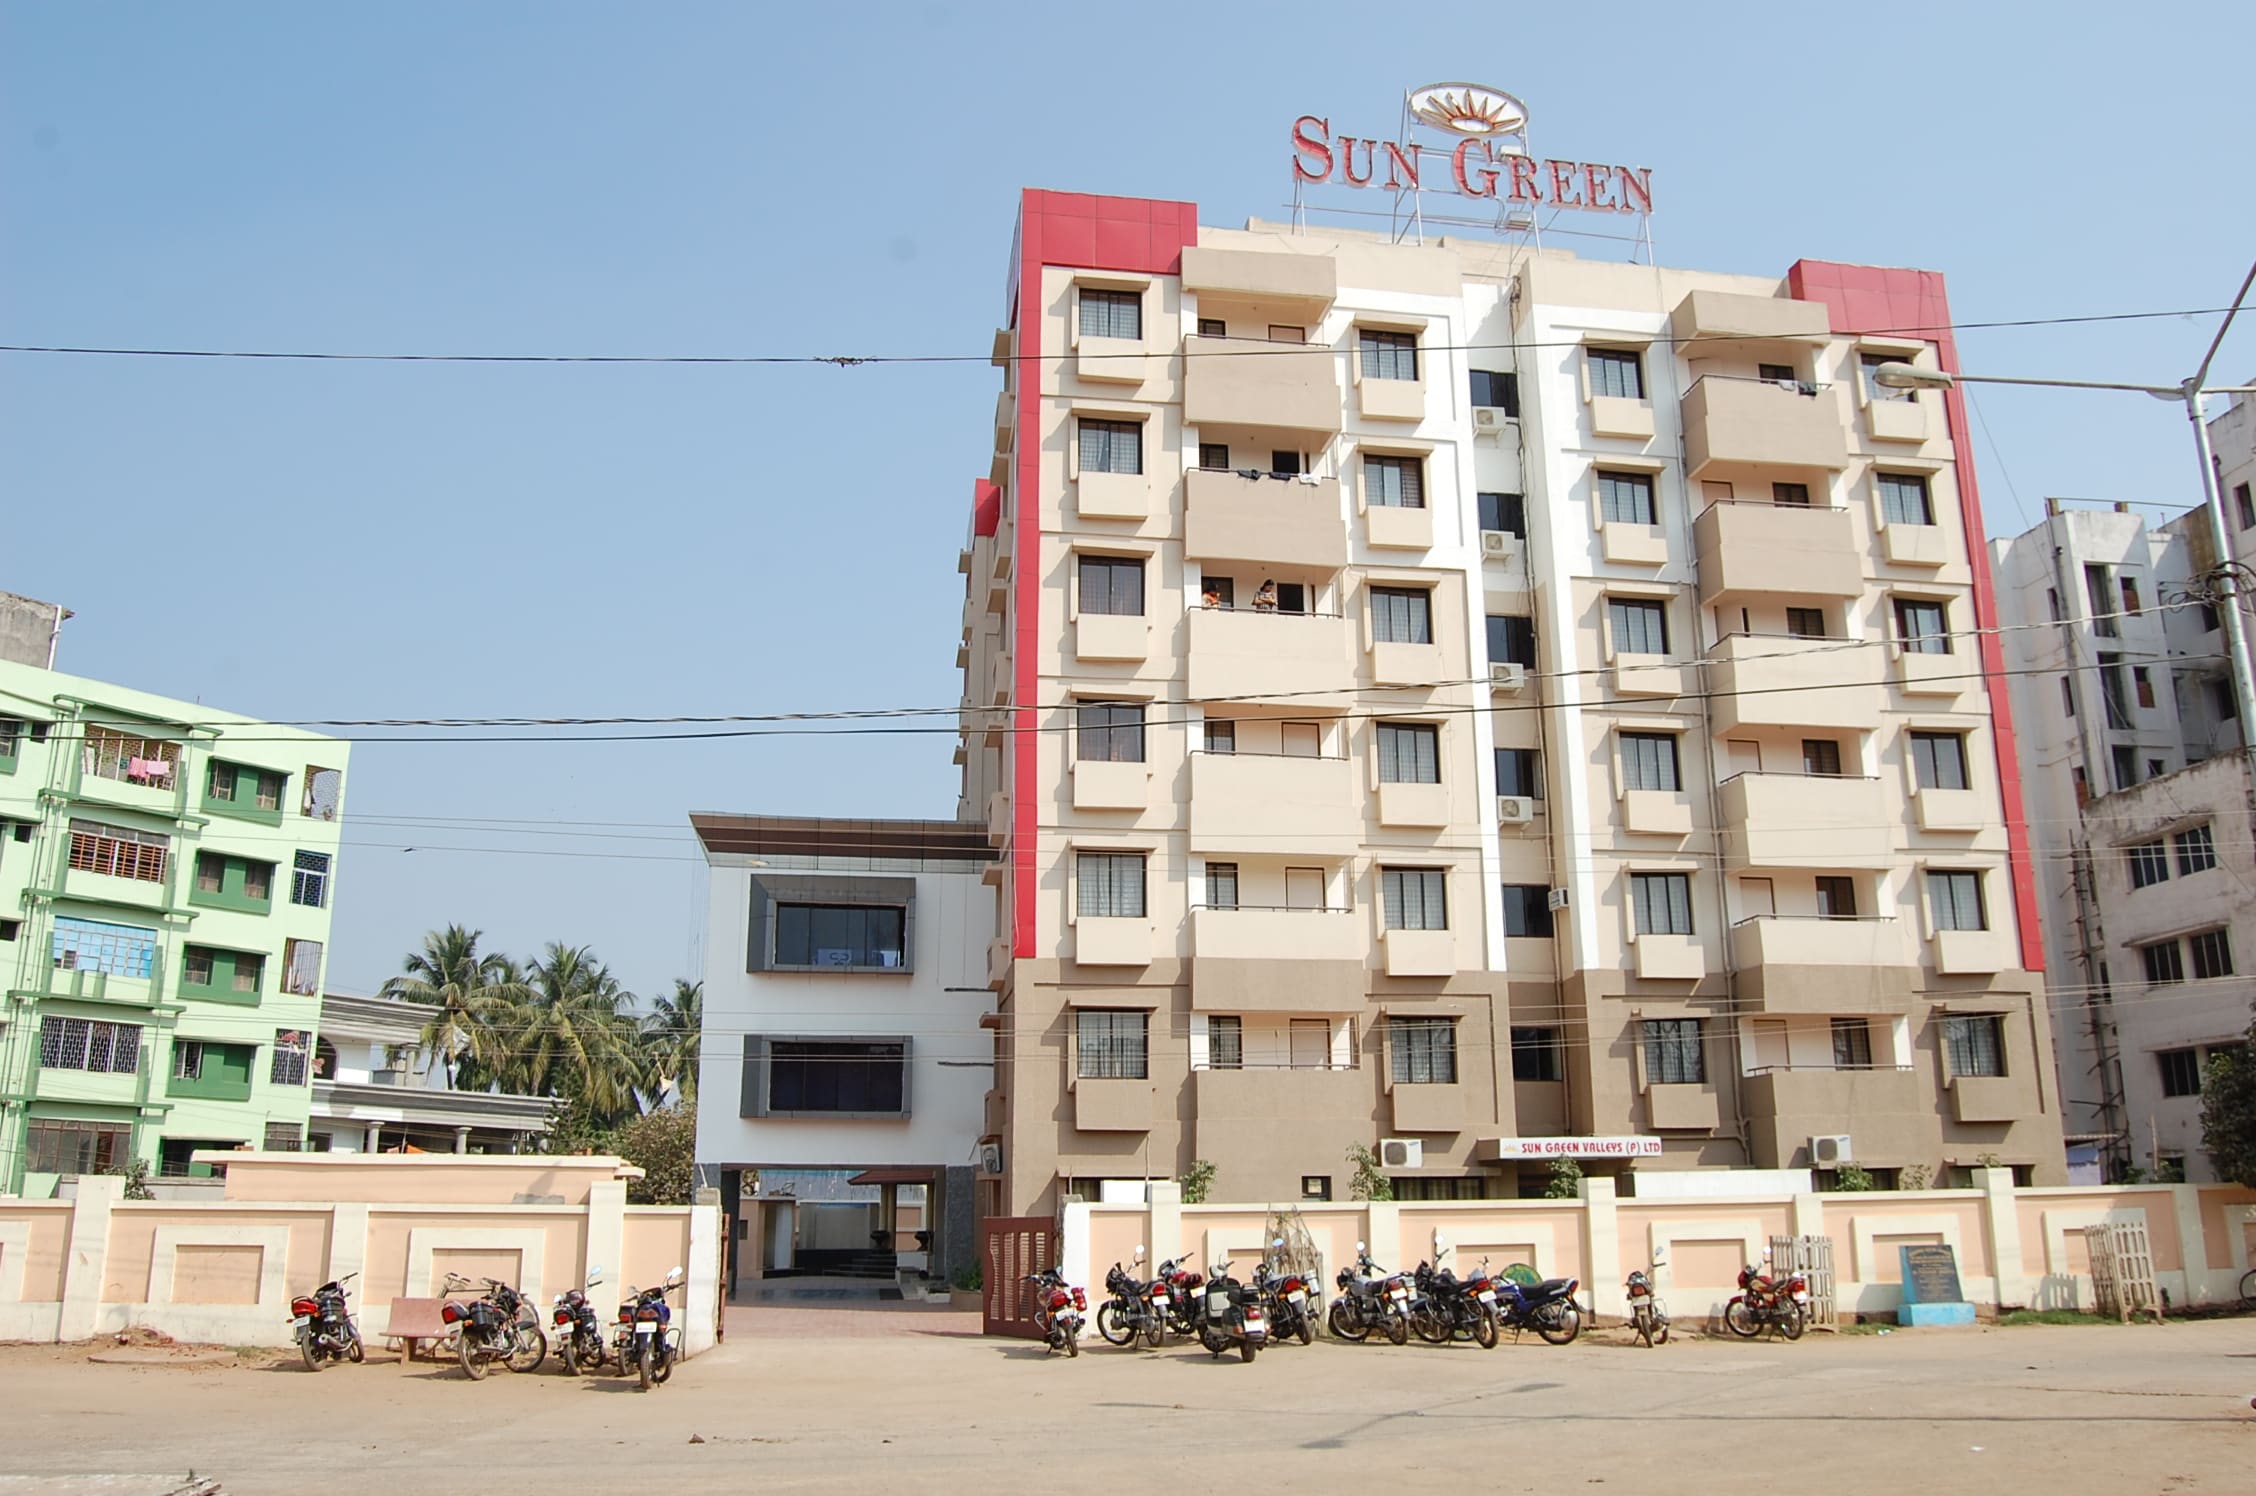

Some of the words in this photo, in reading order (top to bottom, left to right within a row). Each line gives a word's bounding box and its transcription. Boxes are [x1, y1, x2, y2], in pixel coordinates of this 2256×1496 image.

[1291, 114, 1422, 190] SUN
[1451, 137, 1653, 214] GREEN
[1521, 1143, 1541, 1153] SUN
[1545, 1143, 1579, 1153] GREEN
[1583, 1142, 1622, 1153] VALLEYS
[1626, 1142, 1641, 1154] (P)
[1644, 1142, 1660, 1152] LTD
